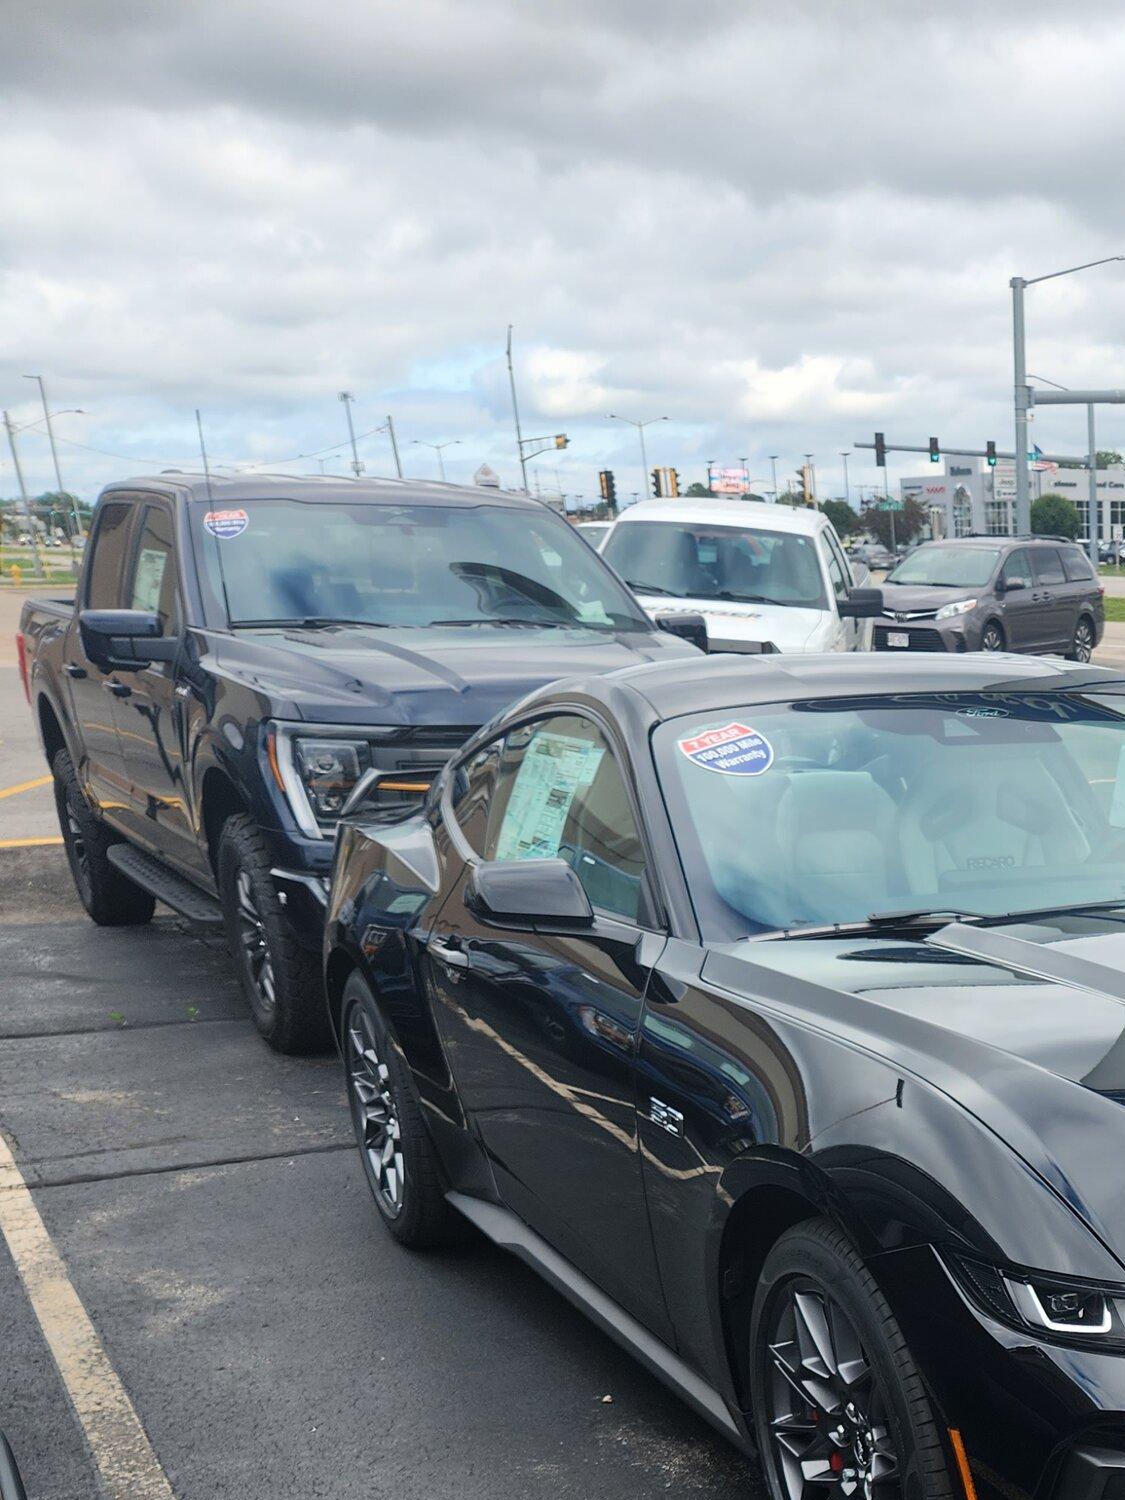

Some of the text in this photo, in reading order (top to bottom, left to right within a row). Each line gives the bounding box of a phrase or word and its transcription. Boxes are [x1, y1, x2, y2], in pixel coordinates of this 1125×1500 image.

[701, 728, 742, 746] YEAR
[696, 738, 764, 762] 100,000 Mile
[714, 749, 767, 769] Warranty
